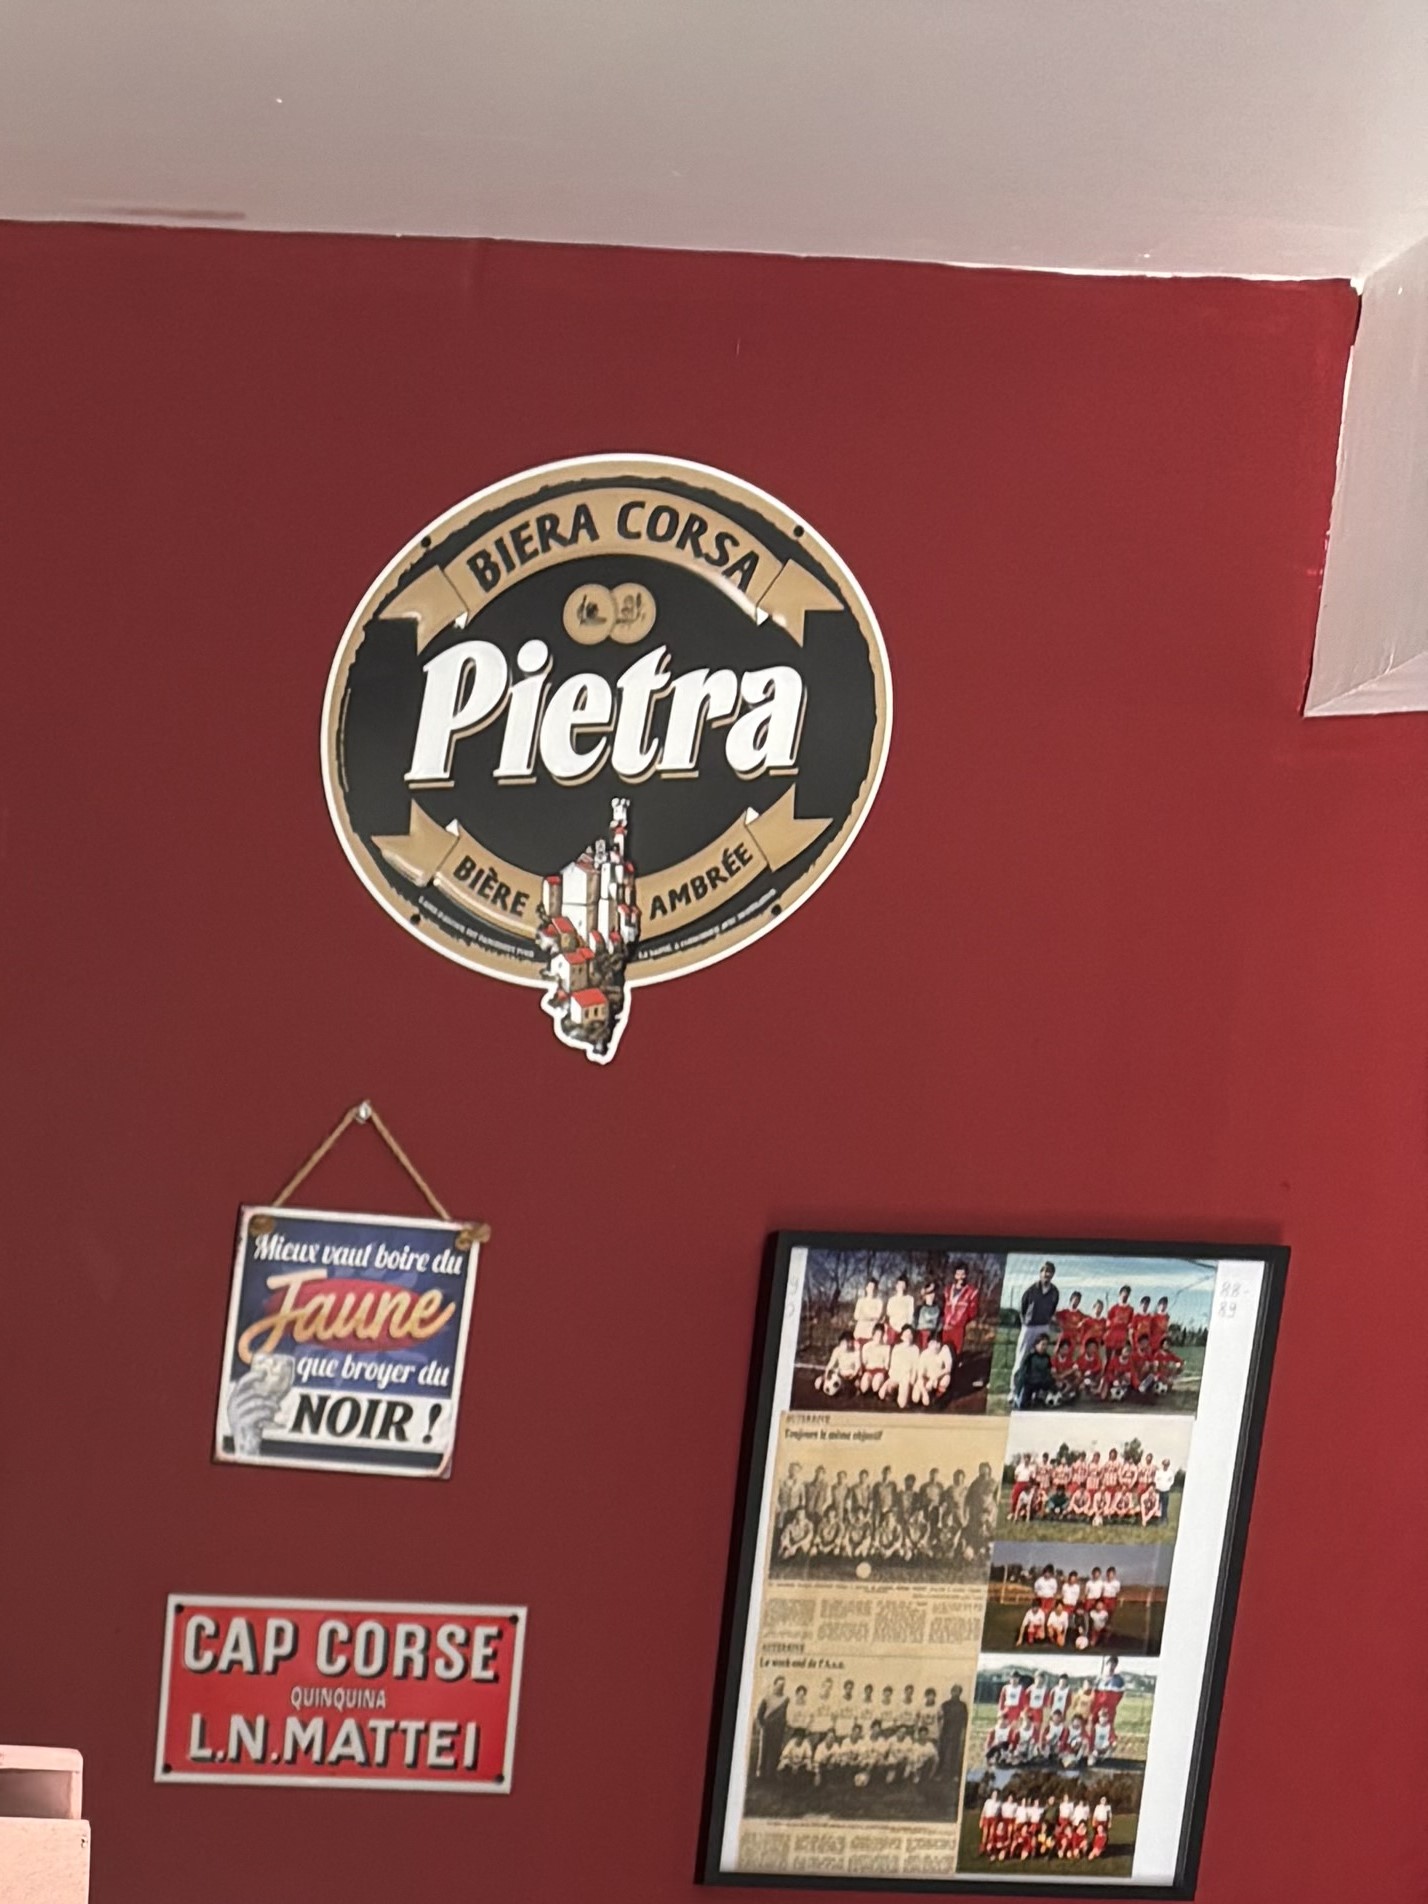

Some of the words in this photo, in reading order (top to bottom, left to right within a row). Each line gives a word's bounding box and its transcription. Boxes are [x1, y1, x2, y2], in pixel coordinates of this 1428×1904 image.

[467, 502, 601, 595] BIERA
[617, 500, 763, 594] CORSA
[402, 638, 806, 789] Pietra
[452, 853, 532, 919] BIÈRE
[649, 841, 755, 923] AMBRÉE
[254, 1232, 320, 1265] Mieux
[322, 1243, 370, 1268] vaut
[375, 1246, 429, 1273] boire
[431, 1247, 464, 1276] du
[238, 1268, 457, 1365] Jaune
[297, 1355, 337, 1384] que
[342, 1355, 416, 1390] broyer
[418, 1360, 450, 1389] du
[289, 1393, 415, 1443] NOIR
[184, 1613, 298, 1675] CAP
[316, 1618, 502, 1682] CORSE
[290, 1685, 387, 1711] QUINQUINA
